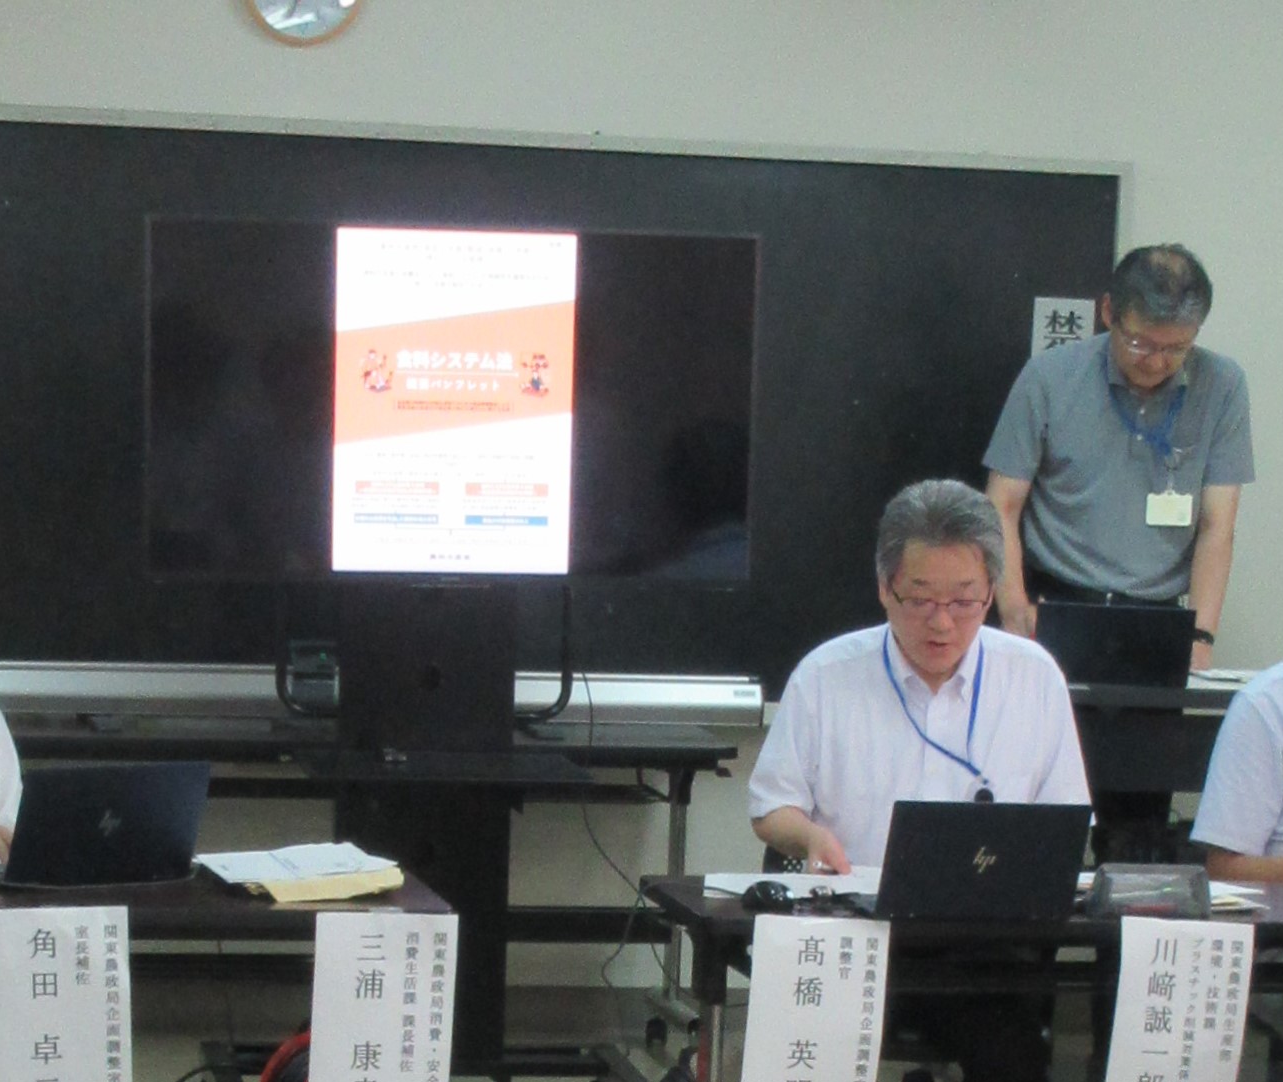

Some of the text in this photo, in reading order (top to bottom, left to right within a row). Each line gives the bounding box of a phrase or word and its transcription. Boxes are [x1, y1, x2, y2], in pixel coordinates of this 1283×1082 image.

[972, 846, 998, 875] hp
[26, 928, 59, 1000] 角田
[355, 933, 387, 1000] 三浦
